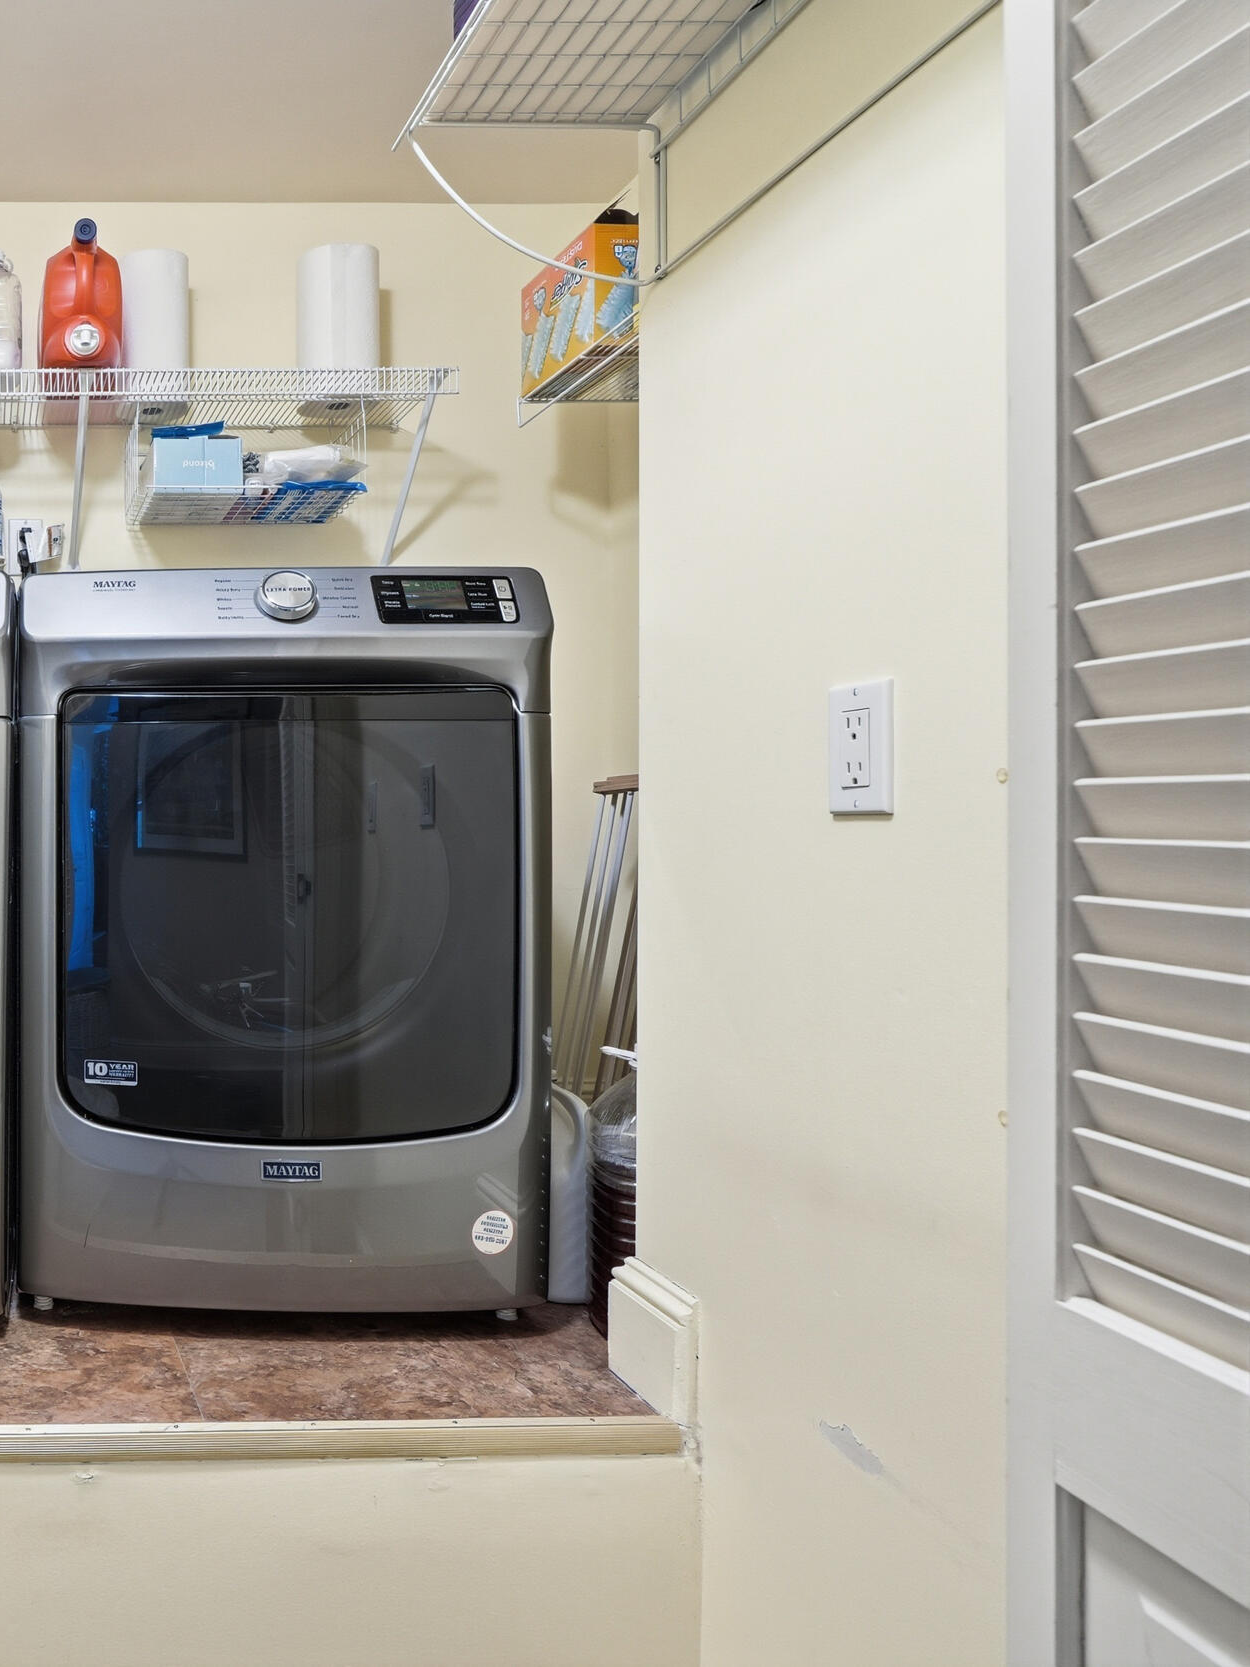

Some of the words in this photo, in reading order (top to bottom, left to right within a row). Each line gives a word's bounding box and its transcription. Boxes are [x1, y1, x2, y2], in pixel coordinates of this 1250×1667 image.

[93, 580, 136, 588] MAYTAG
[87, 1062, 108, 1076] 10
[265, 1165, 319, 1177] MAYTAG
